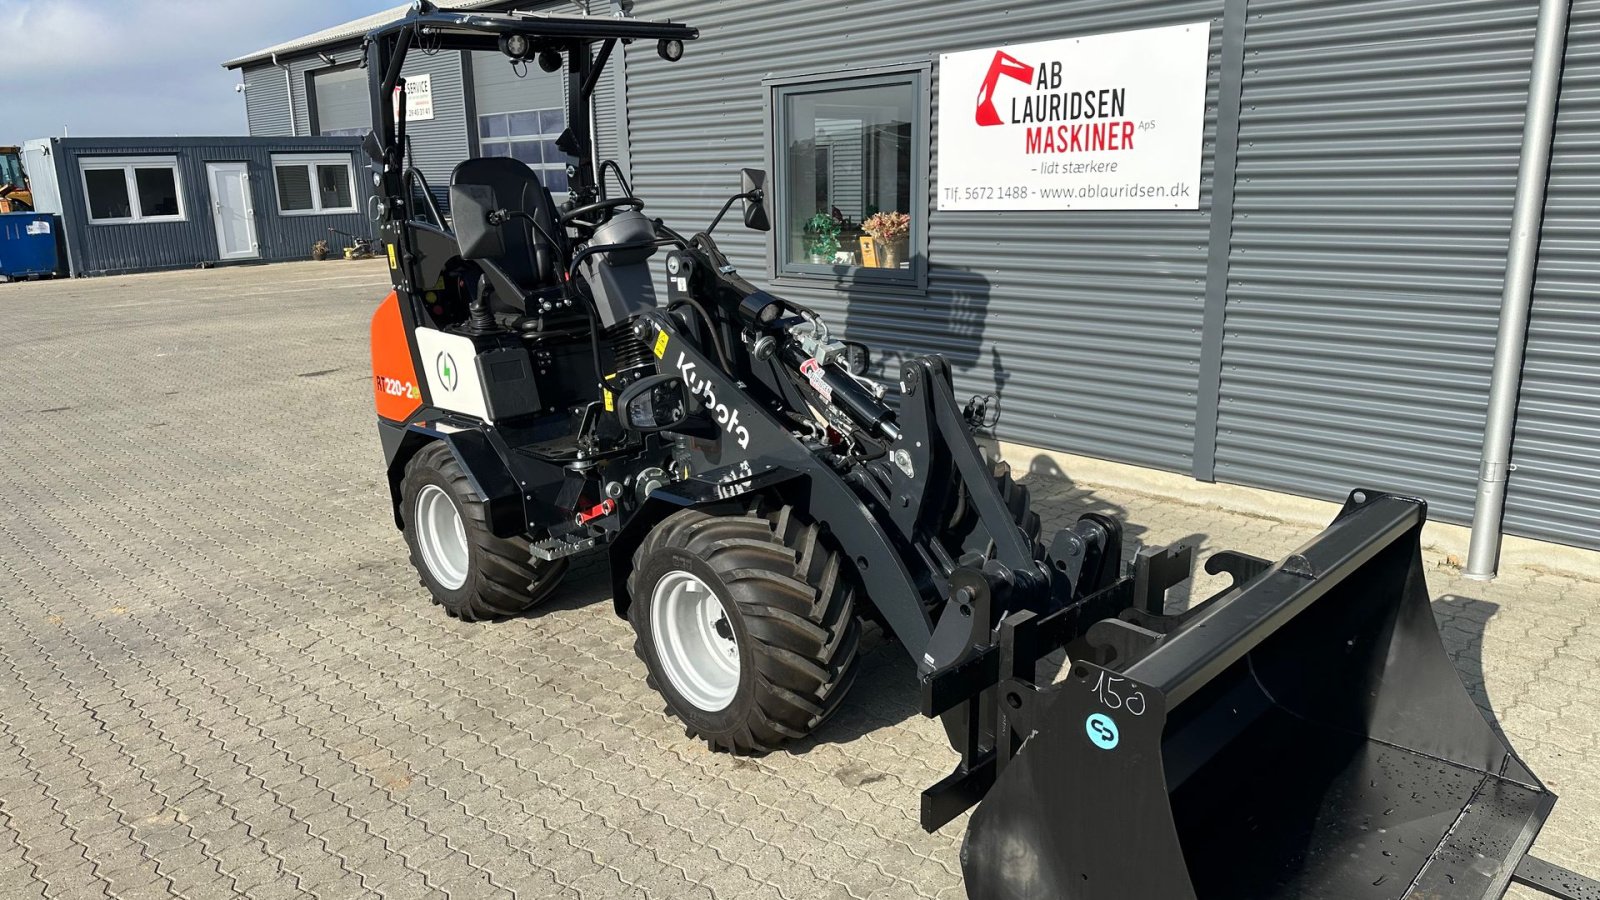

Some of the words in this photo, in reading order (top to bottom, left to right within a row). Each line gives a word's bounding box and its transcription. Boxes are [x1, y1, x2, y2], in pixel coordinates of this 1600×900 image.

[407, 80, 428, 95] SERVICE
[1036, 61, 1063, 91] AB
[1011, 87, 1126, 125] LAURIDSEN
[1025, 120, 1135, 155] MASKINER
[1138, 119, 1156, 132] ApS
[1040, 161, 1060, 175] lidt
[1061, 160, 1119, 175] stærkere
[943, 186, 962, 203] Tlf.
[964, 186, 995, 200] 5672
[996, 185, 1028, 200] 1488
[1039, 182, 1190, 199] www.ablauridsen.dk
[676, 351, 750, 450] Kubota
[1091, 670, 1145, 715] 150
